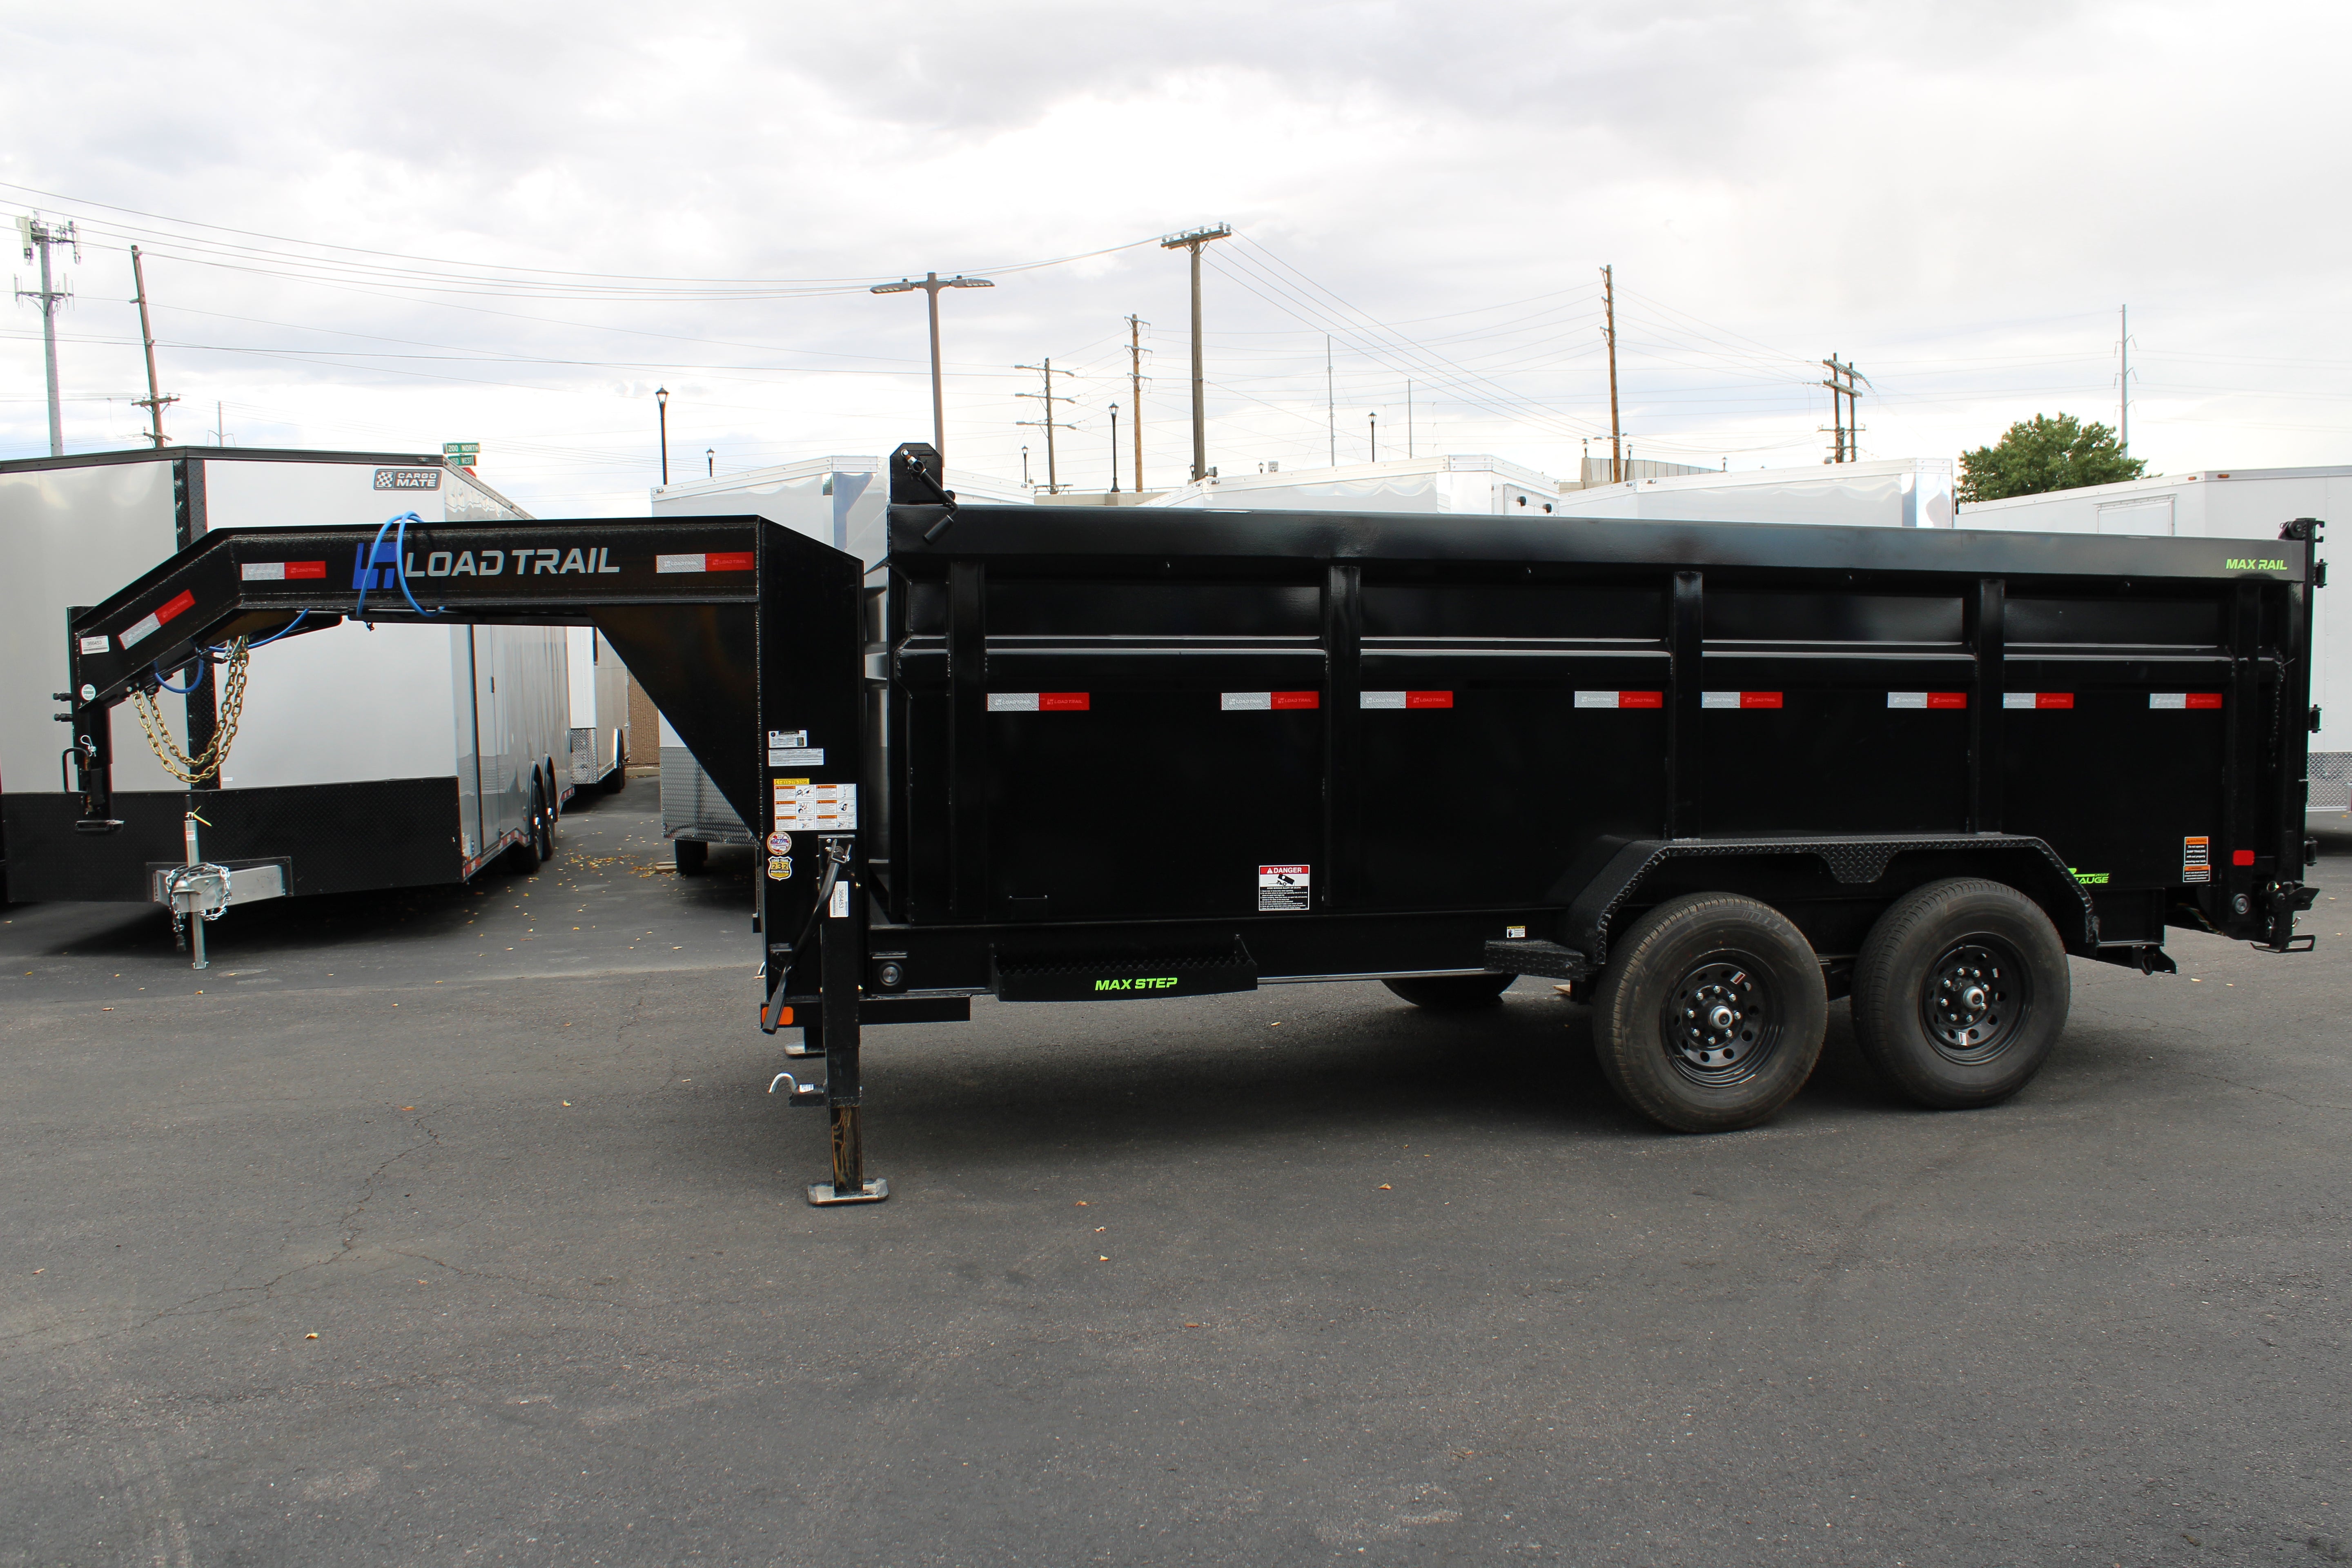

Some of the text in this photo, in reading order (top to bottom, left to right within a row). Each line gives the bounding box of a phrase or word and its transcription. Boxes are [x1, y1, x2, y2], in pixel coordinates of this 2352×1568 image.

[405, 548, 619, 577] LOAD TRAIL
[2226, 559, 2288, 570] MAX RAIL
[1095, 978, 1178, 991] MAX STEP
